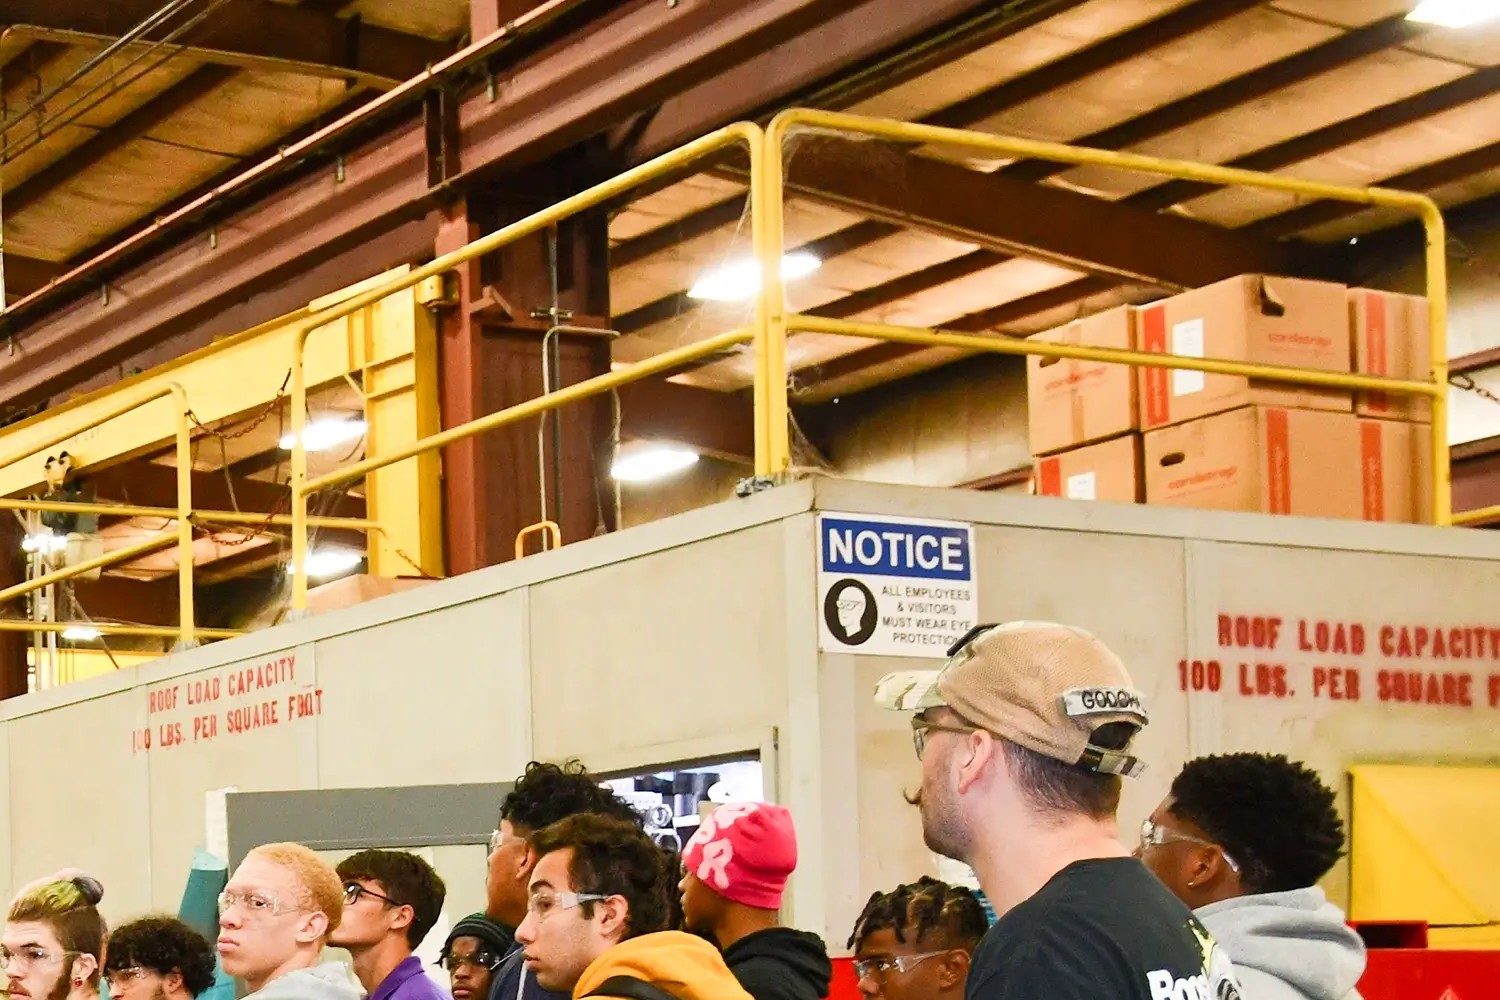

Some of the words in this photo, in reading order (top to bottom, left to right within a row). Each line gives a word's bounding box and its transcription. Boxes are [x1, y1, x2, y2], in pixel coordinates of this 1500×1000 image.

[828, 528, 964, 572] NOTICE
[882, 586, 902, 597] ALL
[905, 587, 971, 601] EMPLOYEES
[897, 602, 904, 612] &
[908, 603, 957, 615] VISITORS
[882, 617, 912, 628] MUST
[916, 619, 948, 630] WEAR
[951, 620, 972, 632] EYE
[1217, 613, 1283, 650] ROOF
[1298, 619, 1366, 656] LOAD
[1379, 624, 1500, 660] CAPACITY
[149, 686, 179, 714] ROOF
[187, 677, 220, 705] LOAD
[228, 655, 296, 697] CAPACITY
[1178, 659, 1222, 693] 100
[1312, 666, 1360, 702] PER
[1376, 668, 1473, 709] SQUARE
[193, 714, 217, 741] PER
[227, 700, 279, 735] SQUARE
